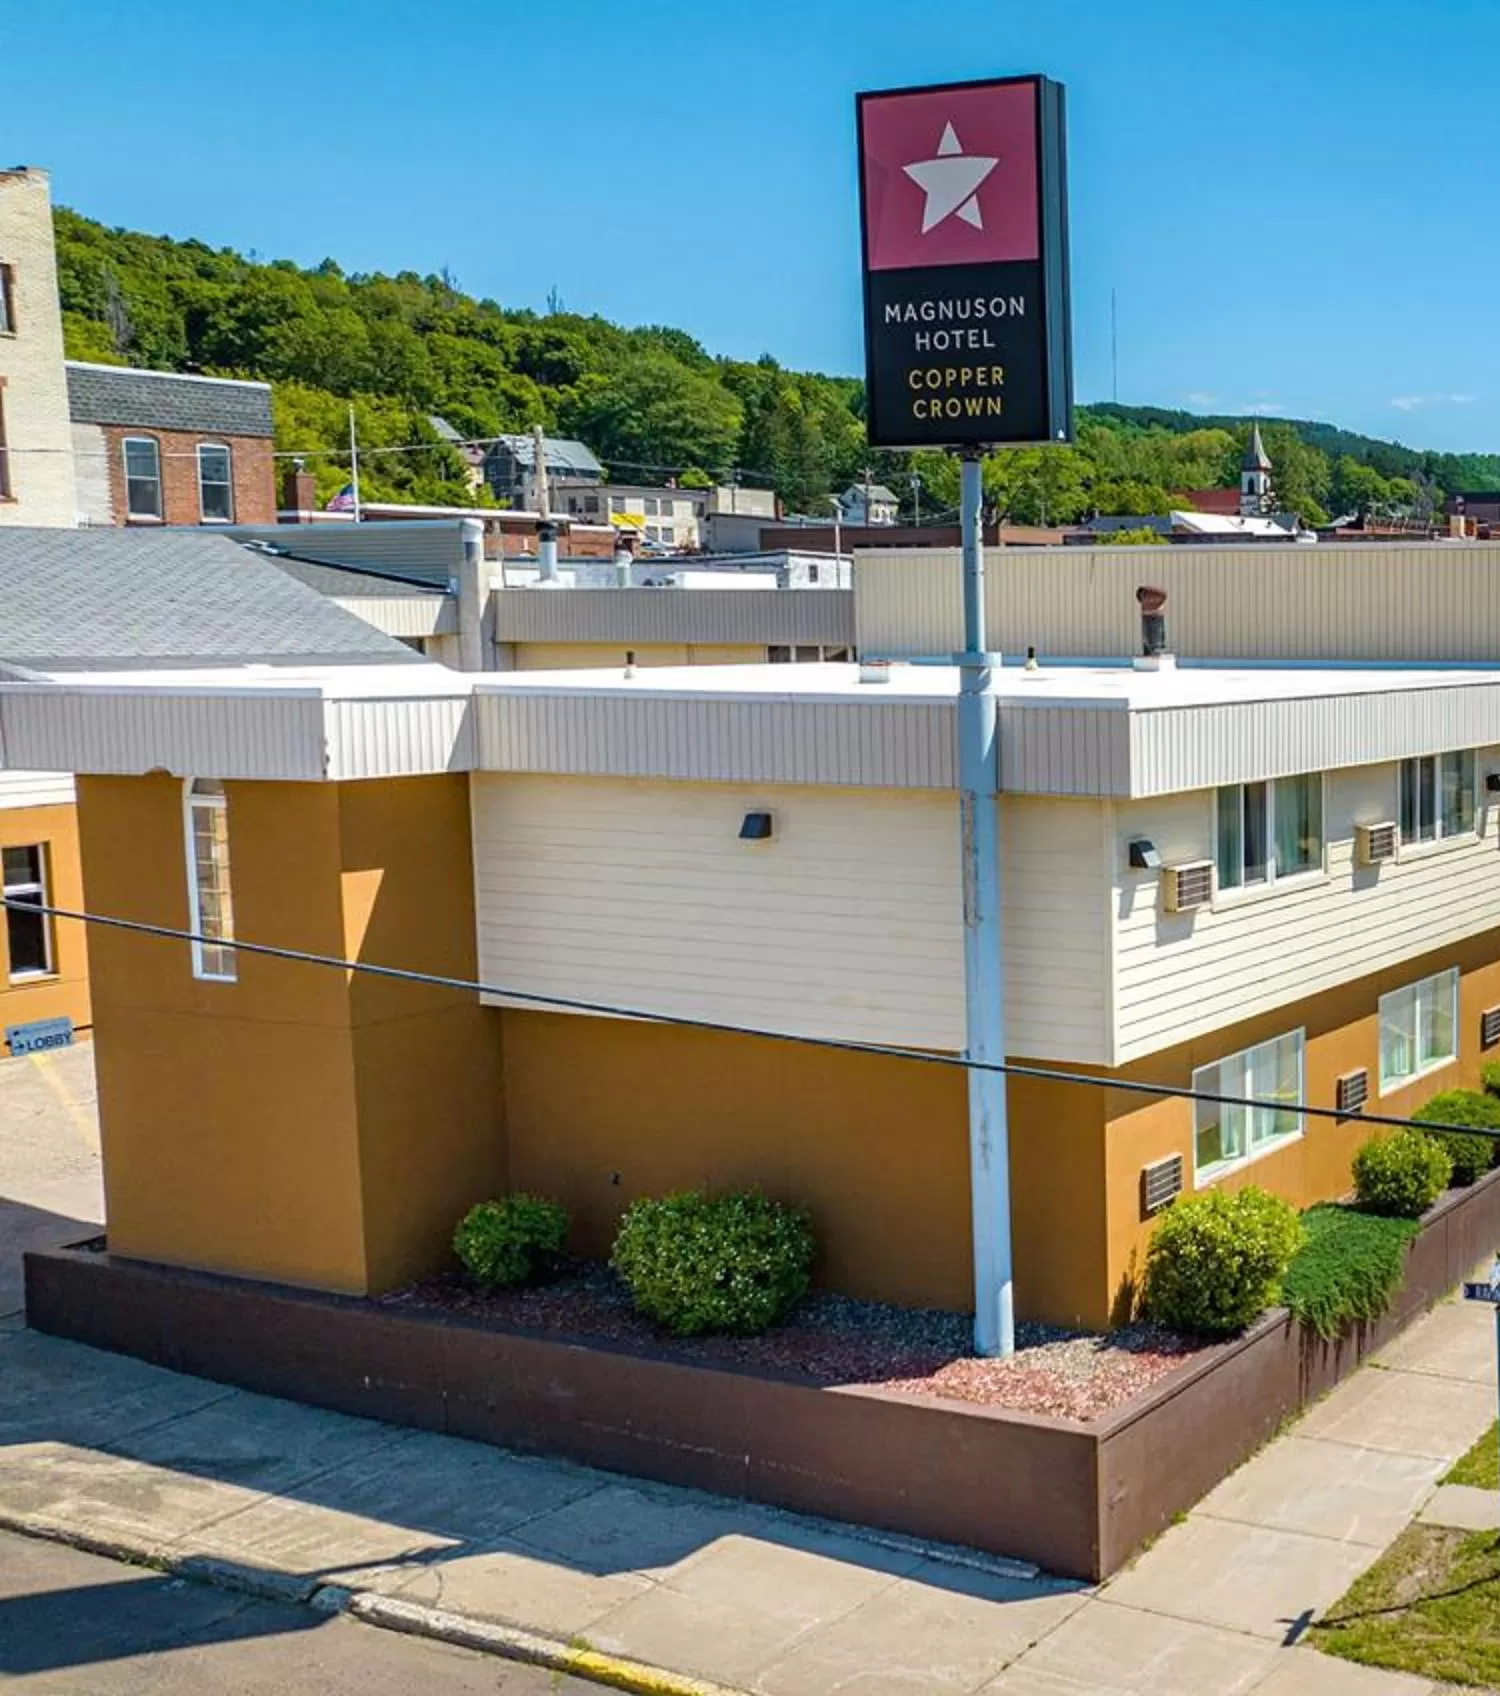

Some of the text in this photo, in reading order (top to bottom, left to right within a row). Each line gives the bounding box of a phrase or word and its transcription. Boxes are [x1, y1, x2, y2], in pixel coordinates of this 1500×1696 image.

[885, 296, 1025, 323] MAGNUSON
[915, 328, 996, 350] HOTEL
[909, 366, 1004, 389] COPPER
[913, 397, 1002, 419] CROWN
[27, 1031, 72, 1051] LOBBY
